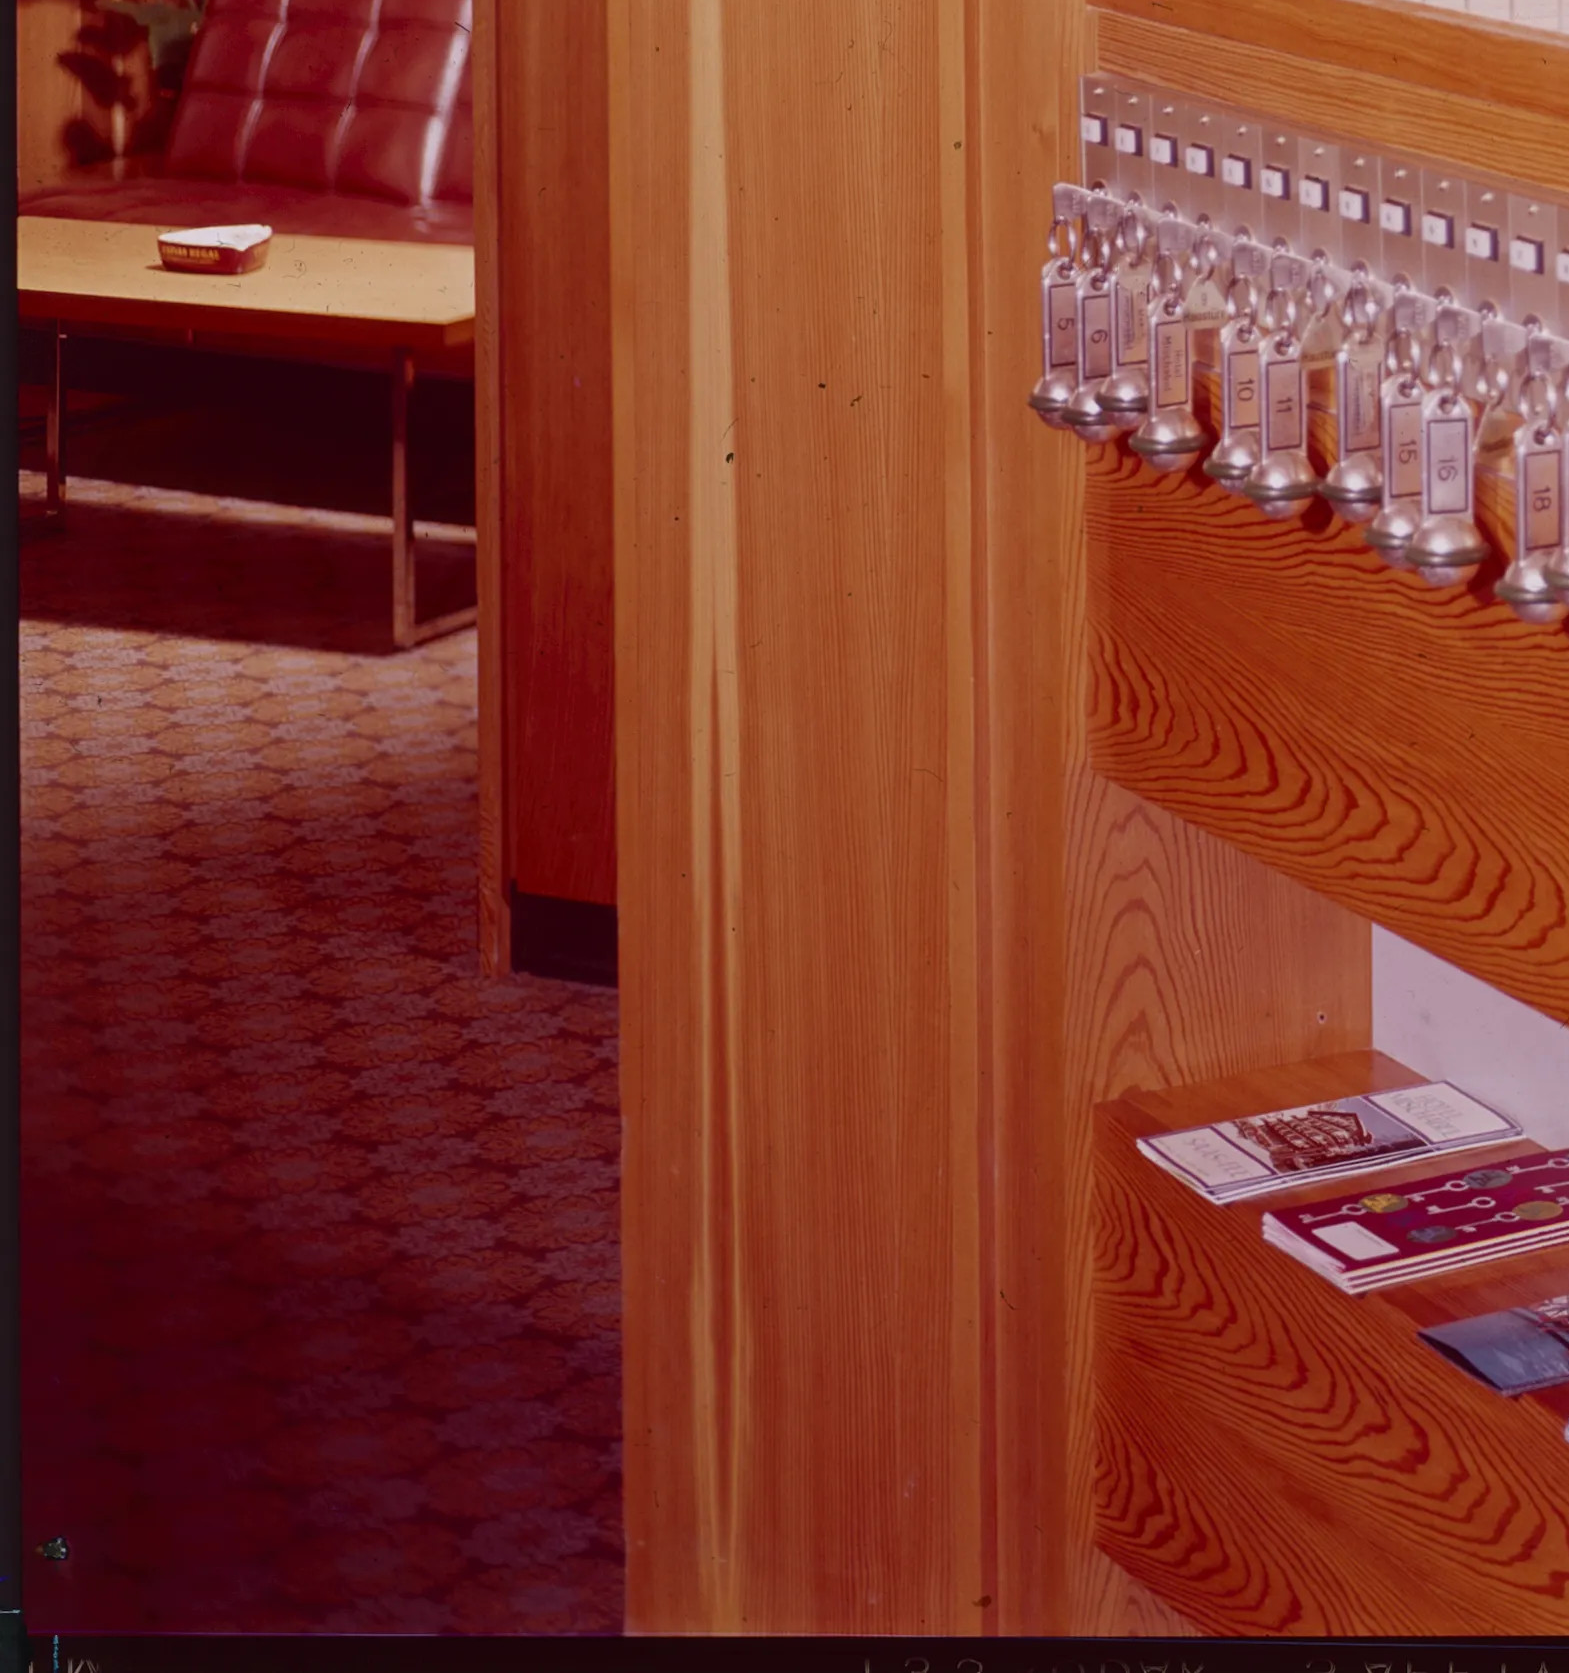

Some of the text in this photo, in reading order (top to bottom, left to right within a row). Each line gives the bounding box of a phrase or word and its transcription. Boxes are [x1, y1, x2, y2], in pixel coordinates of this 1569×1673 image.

[189, 247, 219, 260] REGAL
[1057, 318, 1074, 331] 5
[1091, 329, 1108, 344] 6
[1237, 378, 1254, 402] 10
[1276, 397, 1292, 414] 11
[1398, 440, 1417, 465] 15
[1438, 456, 1458, 482] 16
[1532, 487, 1552, 512] 18
